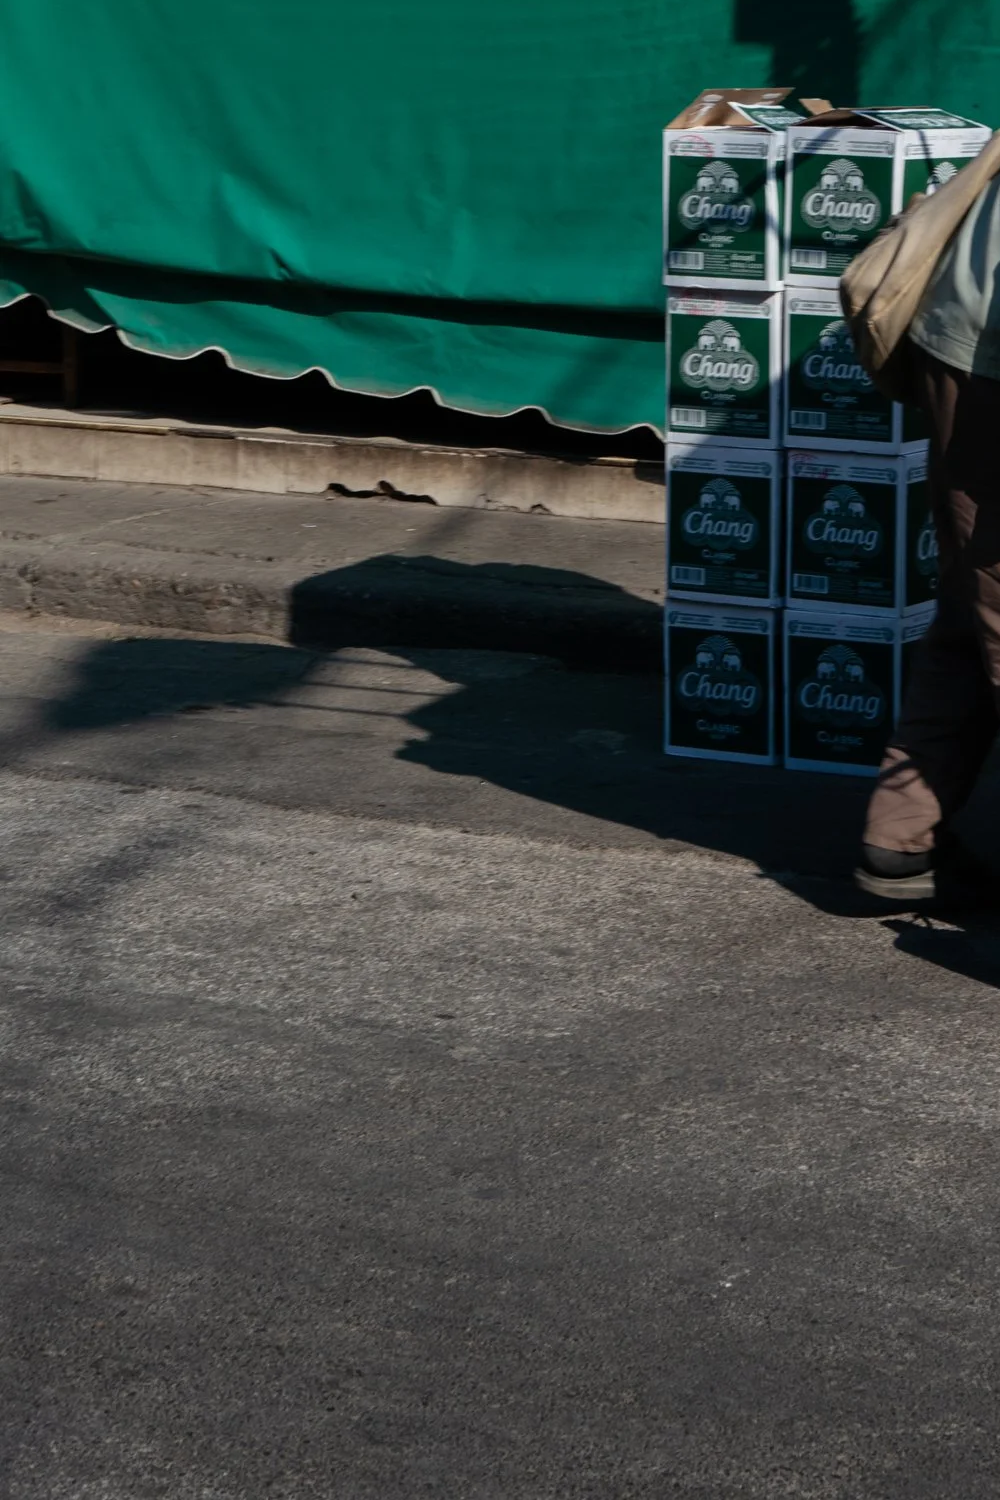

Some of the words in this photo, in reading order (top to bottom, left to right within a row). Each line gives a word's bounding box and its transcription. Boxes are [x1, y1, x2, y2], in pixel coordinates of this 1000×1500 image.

[681, 194, 752, 226] Chang
[804, 192, 878, 225] Chang
[682, 350, 755, 383] Chang
[682, 510, 756, 544] Chang
[805, 517, 880, 552] Chang
[678, 670, 760, 709] Chang
[799, 681, 883, 720] Chang
